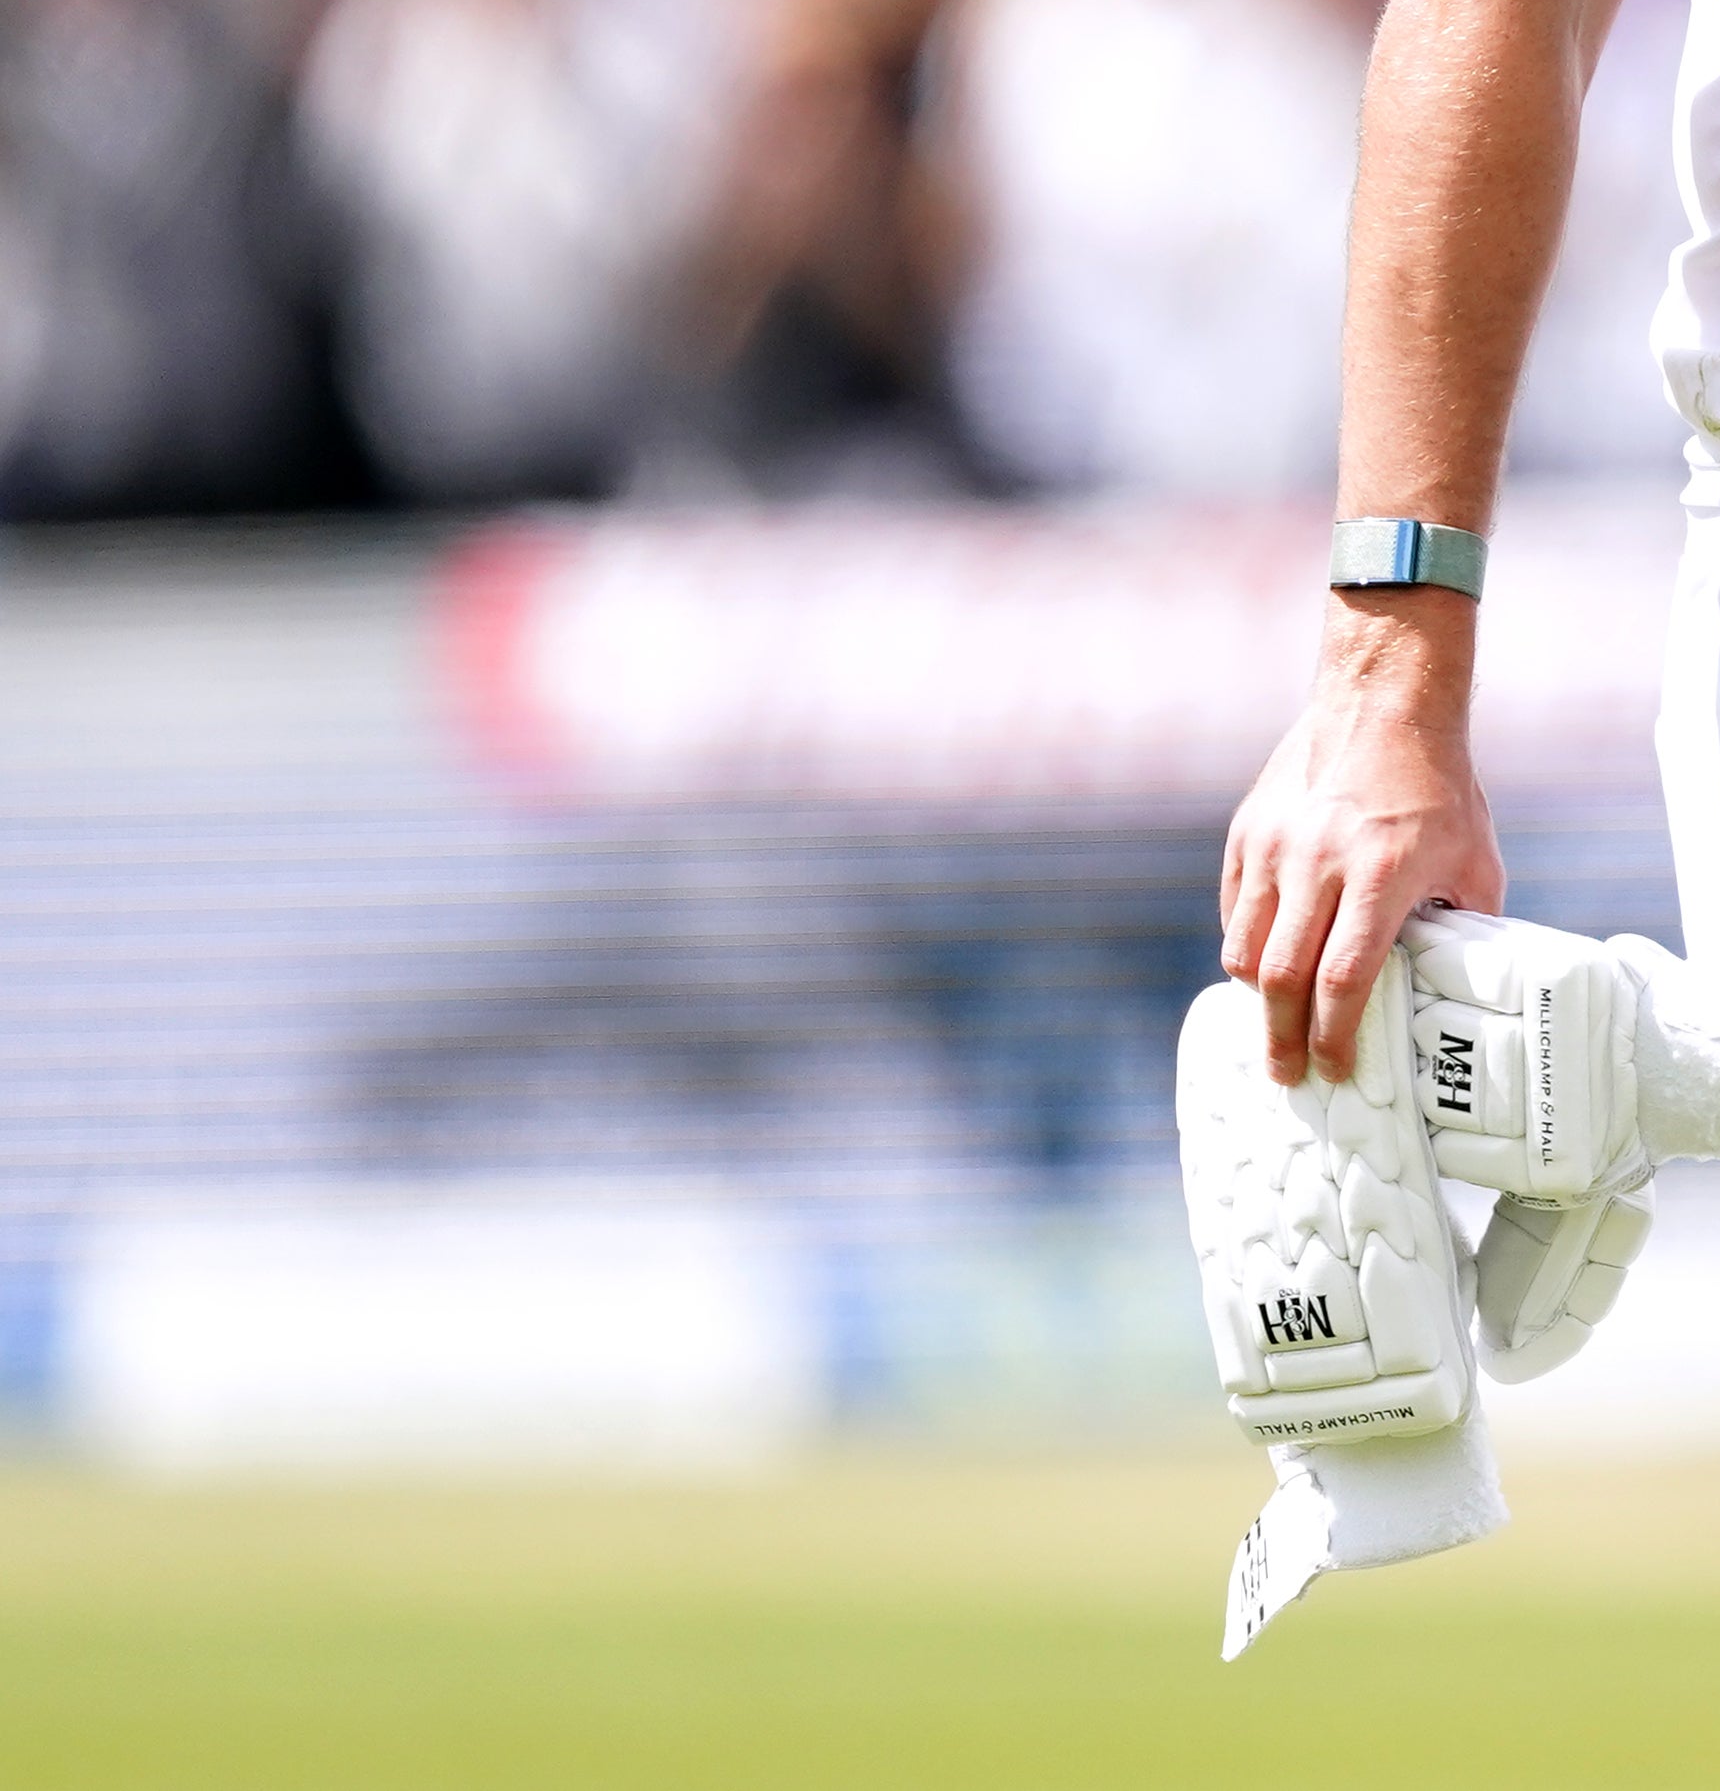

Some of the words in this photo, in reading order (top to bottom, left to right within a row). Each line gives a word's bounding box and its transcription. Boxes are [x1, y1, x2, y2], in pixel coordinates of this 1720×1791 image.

[1539, 987, 1553, 1097] MILLICHAMP
[1540, 1121, 1554, 1167] HALL
[1254, 1423, 1298, 1436] HALL
[1317, 1406, 1415, 1430] MILLICHAMP
